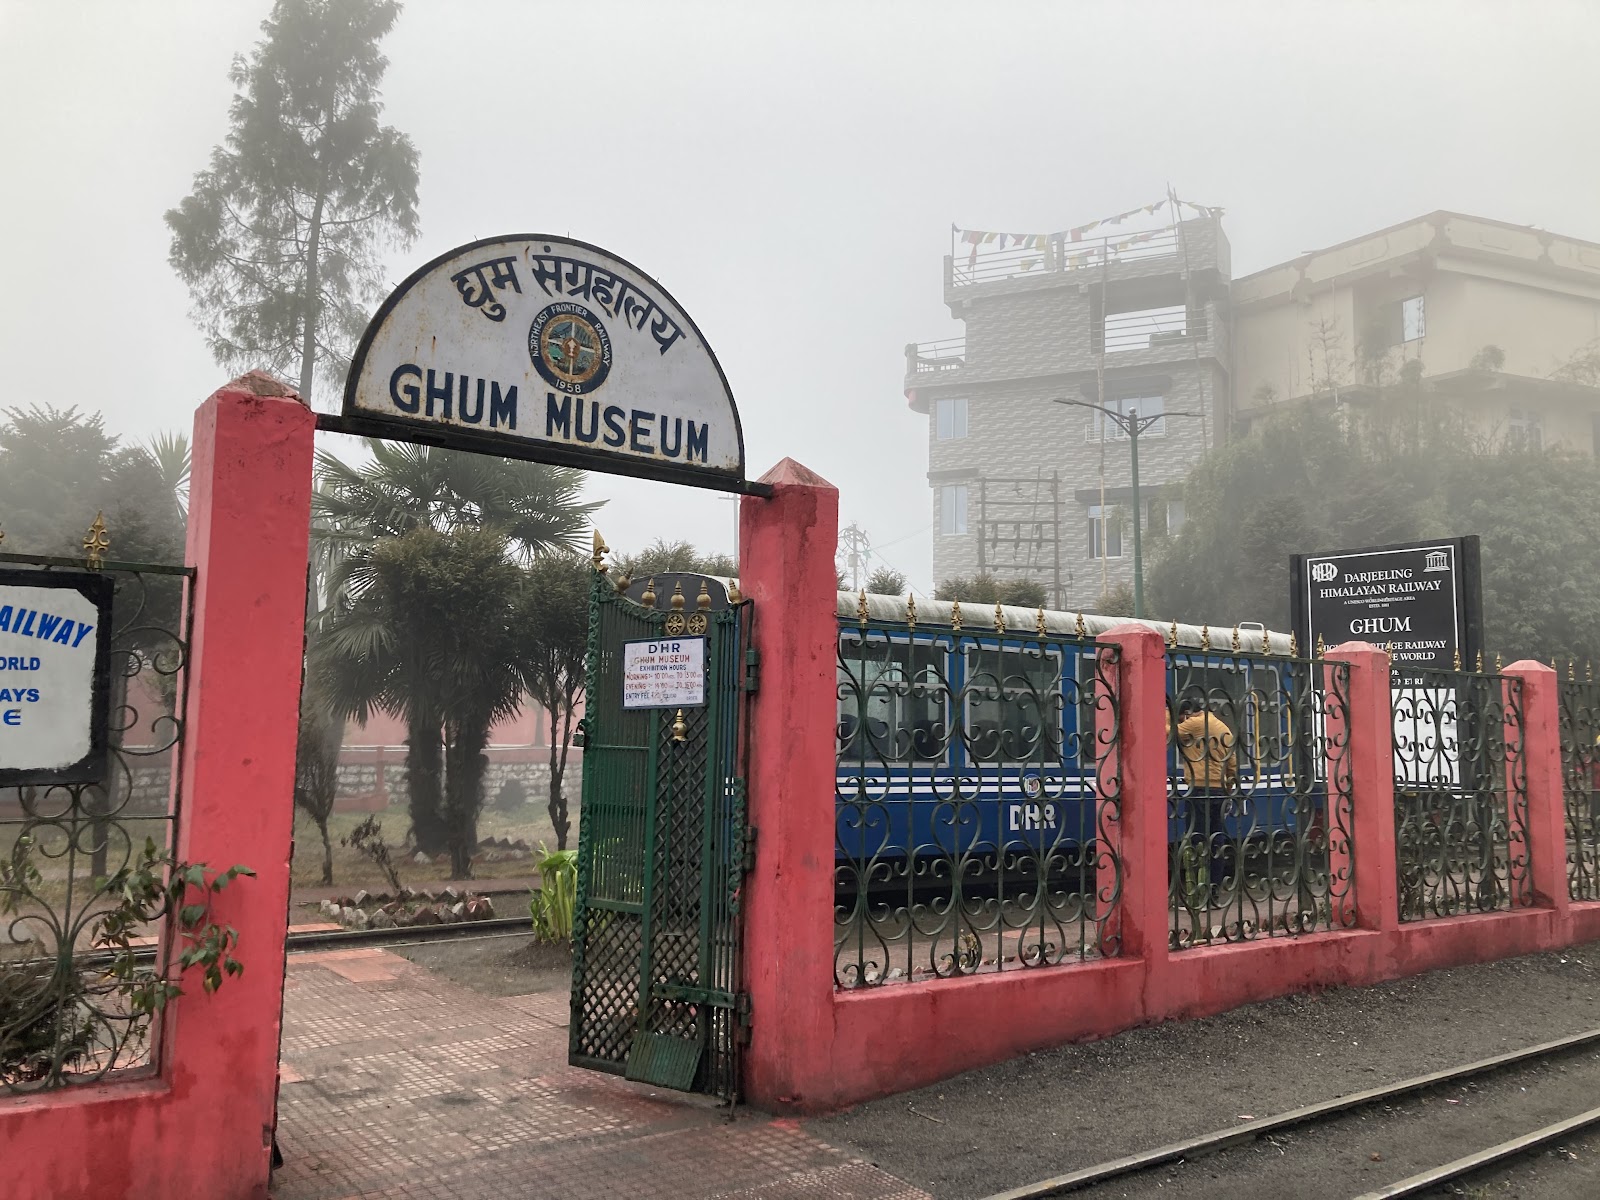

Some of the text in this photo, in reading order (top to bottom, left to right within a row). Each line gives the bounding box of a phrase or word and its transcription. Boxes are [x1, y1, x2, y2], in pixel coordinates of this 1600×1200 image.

[531, 245, 687, 356] संग्रहालय
[530, 303, 612, 367] NORTHEAST FRONTIER RAILWAY
[555, 378, 582, 394] 1958
[389, 363, 709, 464] GHUM MUSEUM
[1344, 568, 1413, 584] DARJEELING
[1320, 580, 1442, 599] HIMALAYAN RAILWAY
[1350, 616, 1412, 634] GHUM
[648, 643, 680, 654] DHR
[1405, 640, 1447, 650] RAILWAY
[0, 656, 41, 671] ORLD
[633, 654, 690, 665] GHUM MUSEUM
[1400, 652, 1436, 661] WORLD
[0, 688, 40, 703] AYS
[1009, 804, 1056, 830] DHR
